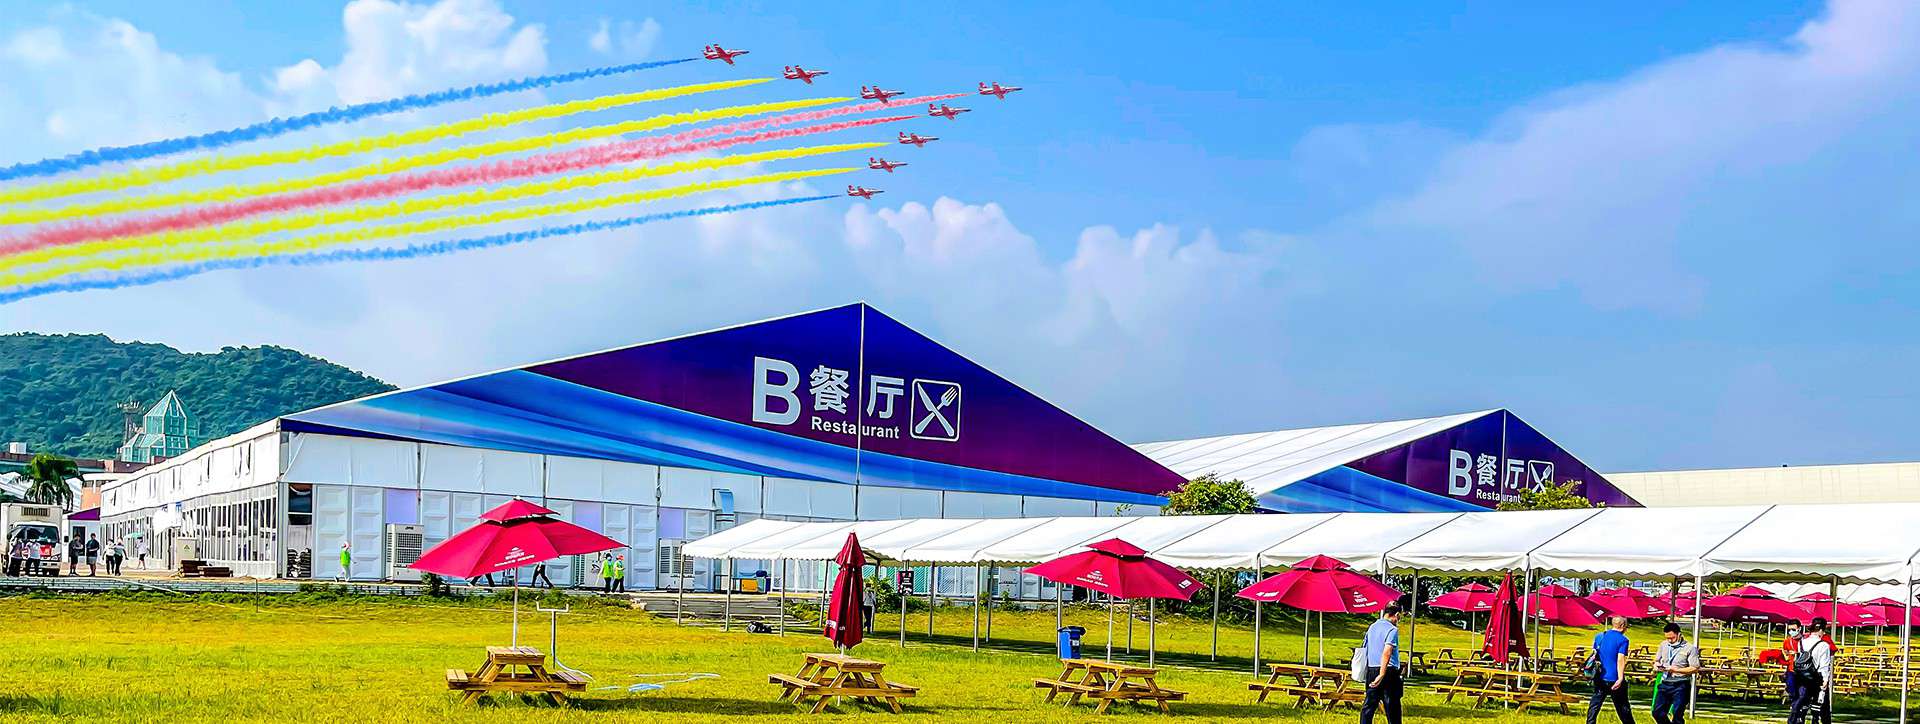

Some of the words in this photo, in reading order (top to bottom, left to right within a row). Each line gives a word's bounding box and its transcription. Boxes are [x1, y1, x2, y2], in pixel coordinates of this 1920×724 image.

[753, 356, 801, 425] B
[810, 365, 904, 419] 餐厅
[811, 416, 900, 439] Restaurant
[1449, 449, 1472, 496] B
[1476, 453, 1525, 489] 餐厅
